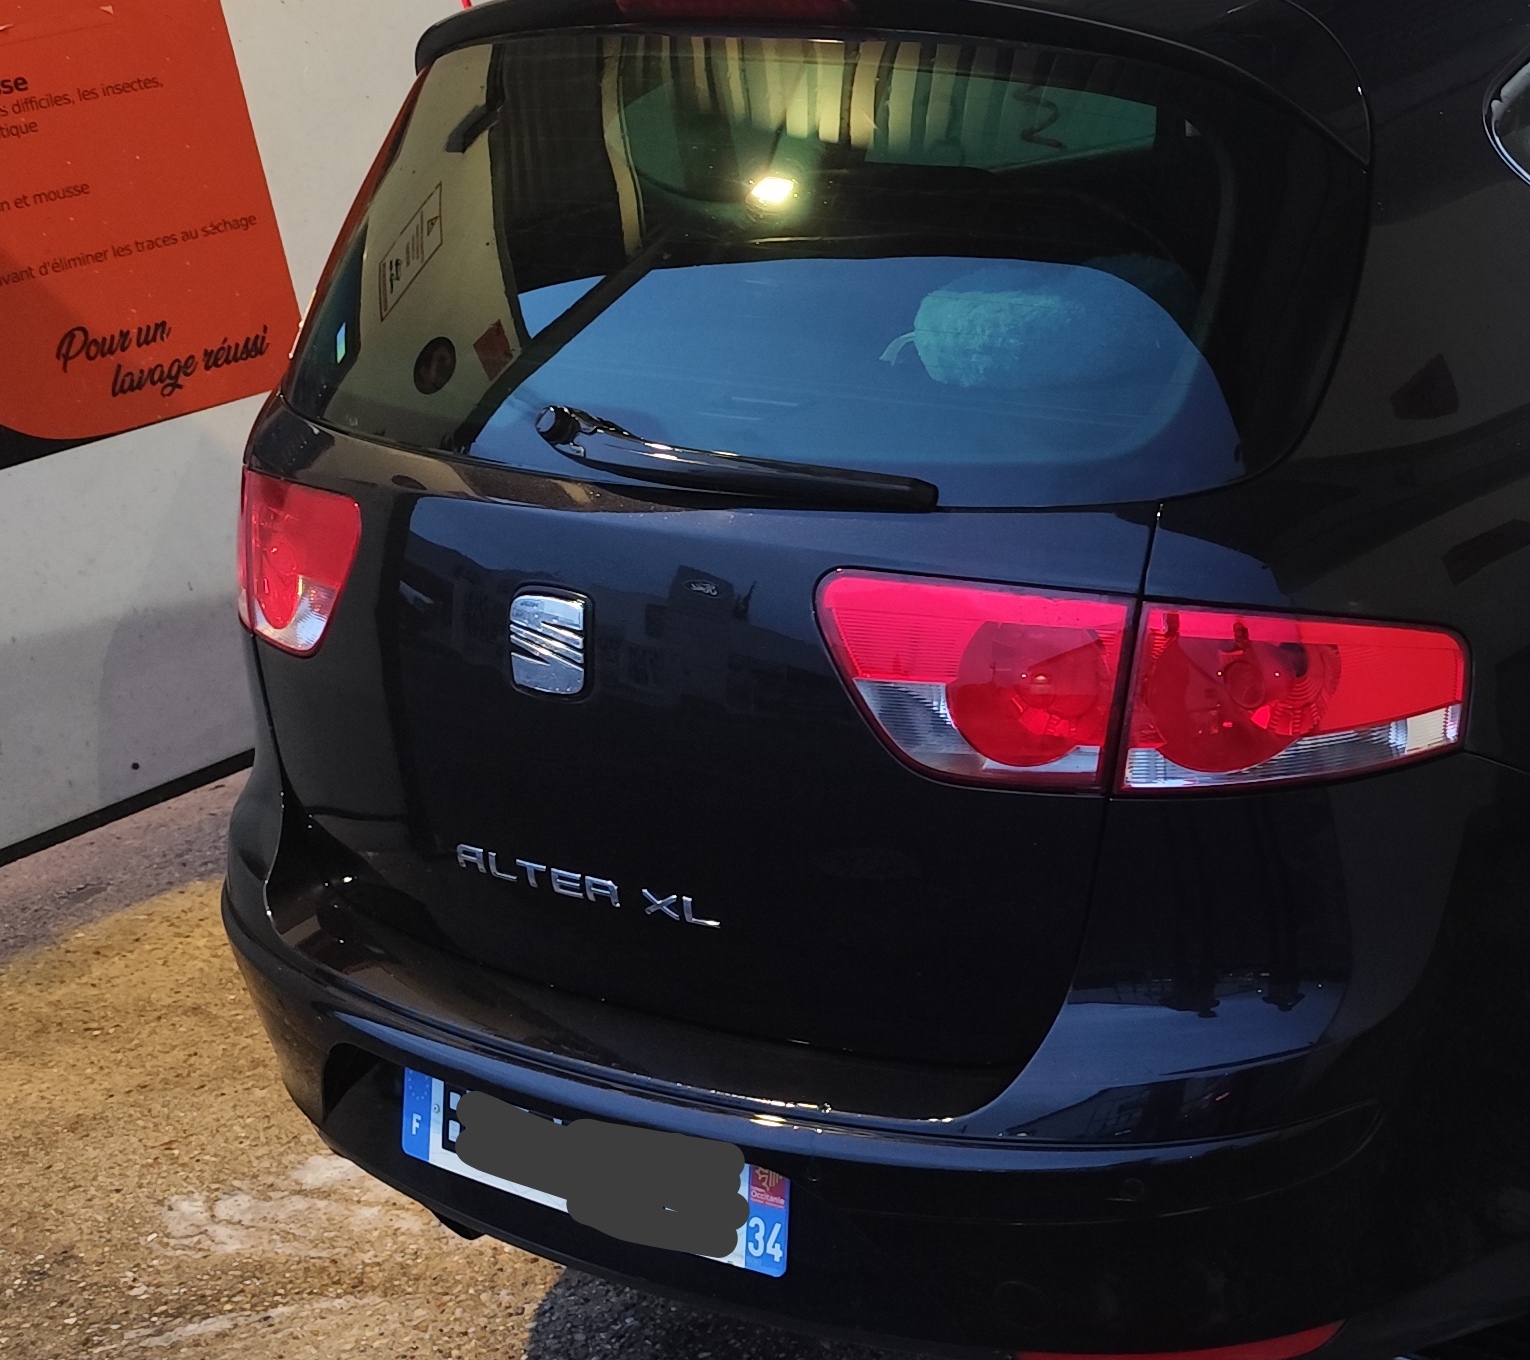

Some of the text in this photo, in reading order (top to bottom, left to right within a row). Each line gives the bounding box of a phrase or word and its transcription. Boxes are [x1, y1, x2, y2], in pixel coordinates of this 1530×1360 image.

[12, 93, 75, 115] difficiles,
[77, 88, 99, 102] les
[101, 77, 164, 97] insectes,
[14, 194, 31, 210] et
[33, 183, 91, 205] mousse
[38, 249, 109, 277] d'éliminer
[111, 244, 133, 259] les
[135, 233, 178, 253] traces
[181, 228, 199, 243] au
[201, 214, 258, 238] séchage
[55, 320, 172, 373] Pour un
[111, 325, 270, 398] lavage réussi
[642, 889, 721, 929] XL
[412, 1112, 422, 1136] F
[748, 1216, 783, 1263] 34
